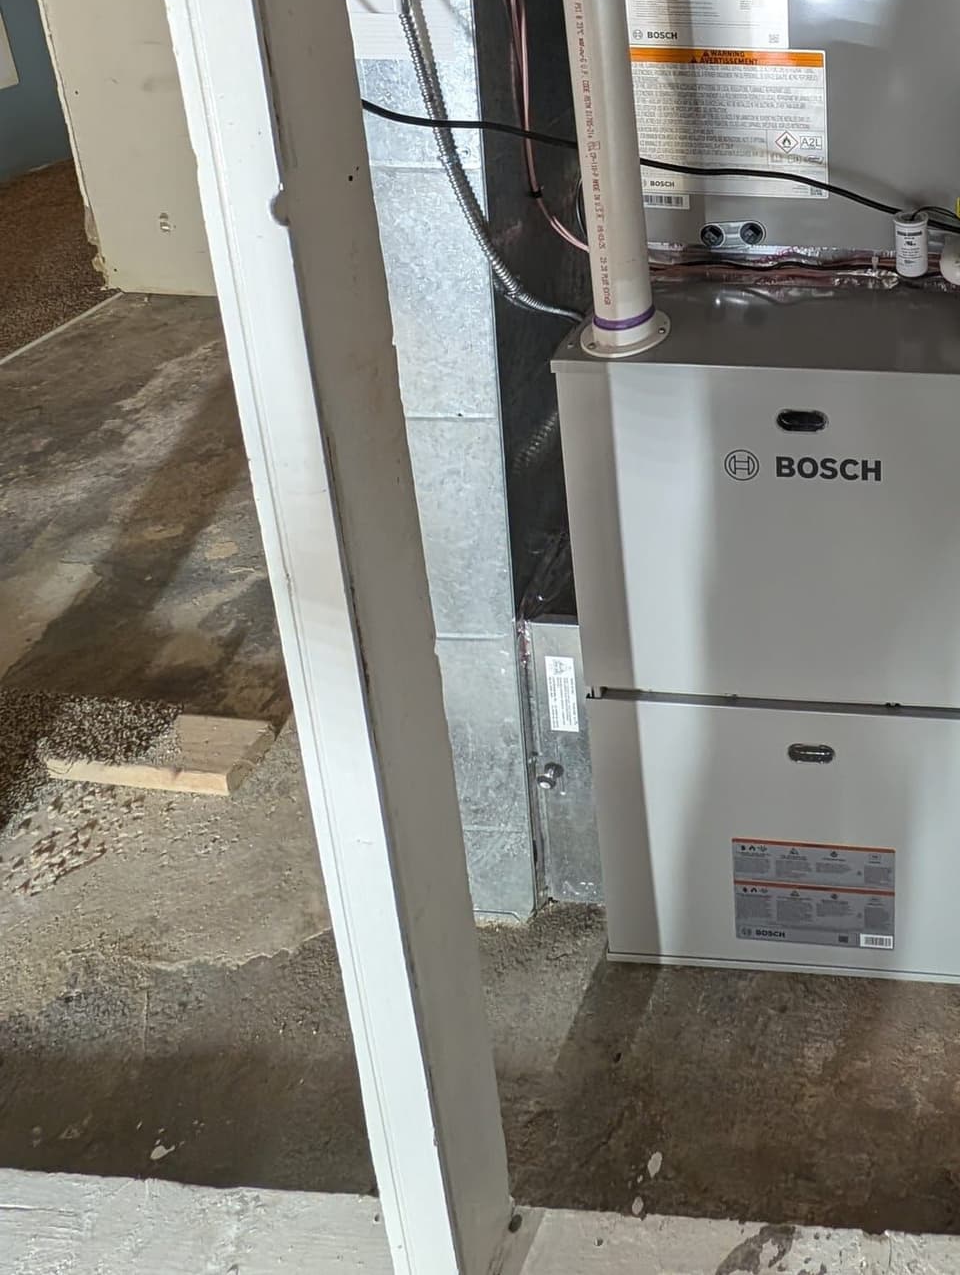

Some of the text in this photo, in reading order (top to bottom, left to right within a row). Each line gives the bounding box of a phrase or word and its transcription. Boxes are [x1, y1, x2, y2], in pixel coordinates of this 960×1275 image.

[647, 31, 678, 40] BOSCH
[710, 50, 744, 58] WARNING
[700, 57, 758, 66] AVERTISSEMENT
[801, 138, 821, 148] A2L
[650, 180, 675, 188] BOSCH
[775, 455, 882, 482] BOSCH
[755, 929, 786, 938] BOSCH
